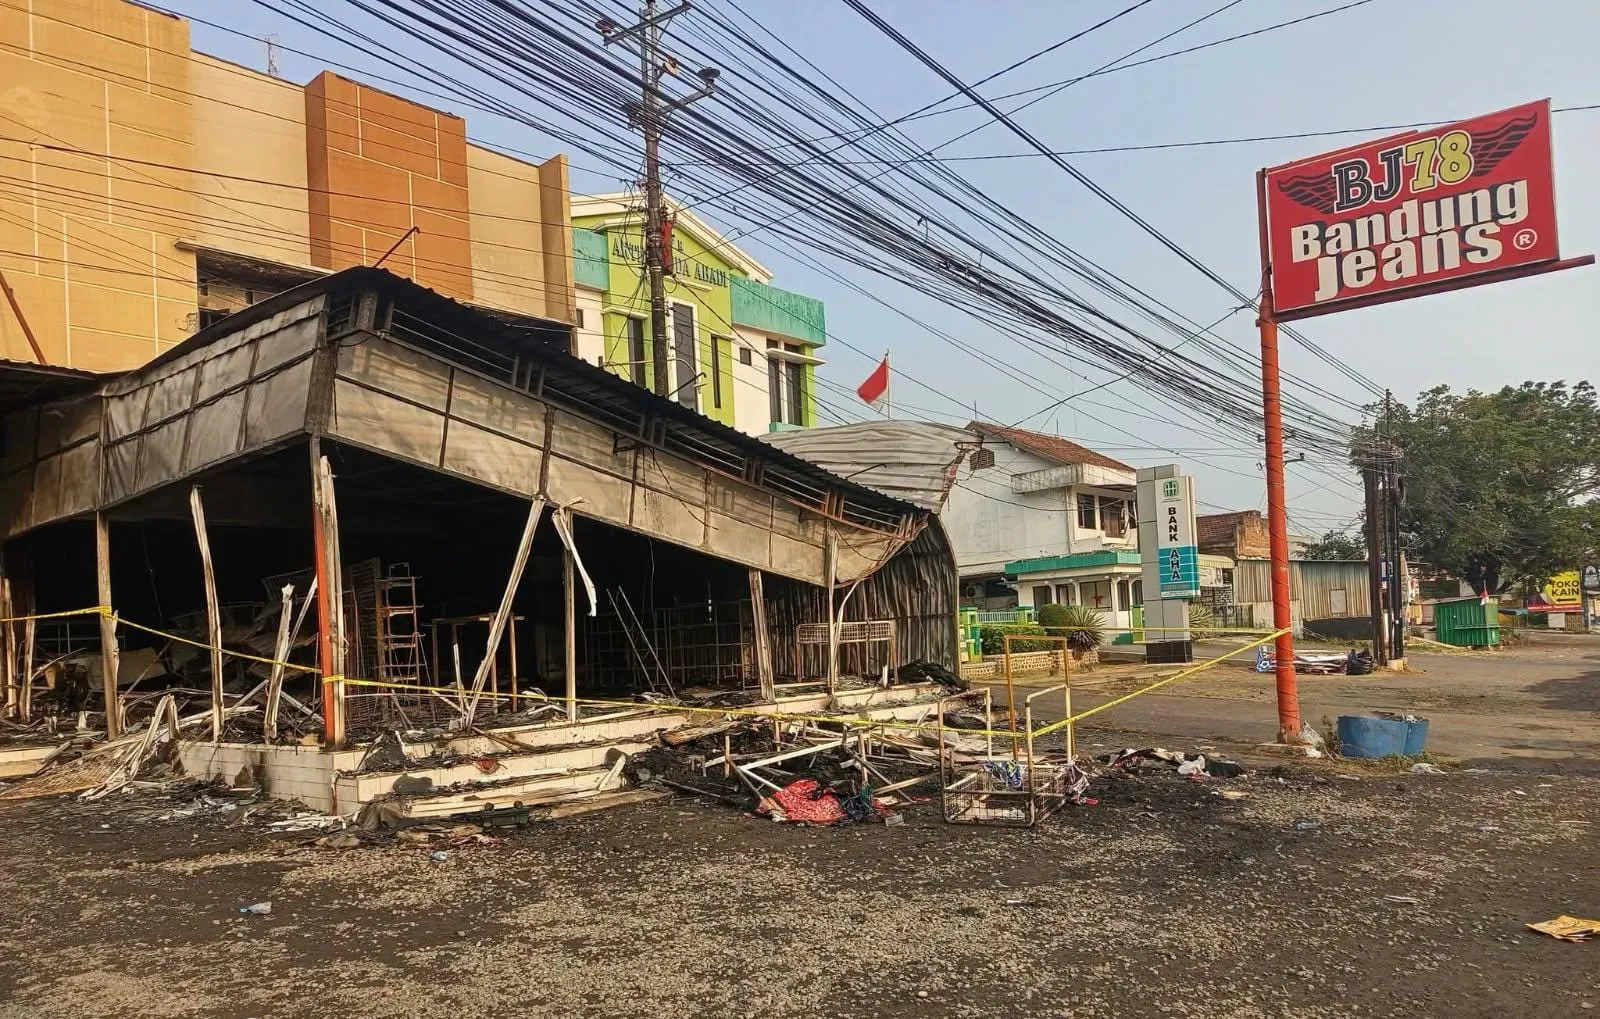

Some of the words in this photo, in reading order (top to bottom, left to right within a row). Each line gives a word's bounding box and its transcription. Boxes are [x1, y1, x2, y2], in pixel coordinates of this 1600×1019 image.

[1332, 130, 1474, 214] BJ78
[1291, 180, 1529, 263] Bandung
[1168, 507, 1178, 541] BANK
[1170, 549, 1182, 581] AHA
[1551, 588, 1579, 597] KAIN
[1552, 580, 1579, 588] TOKO
